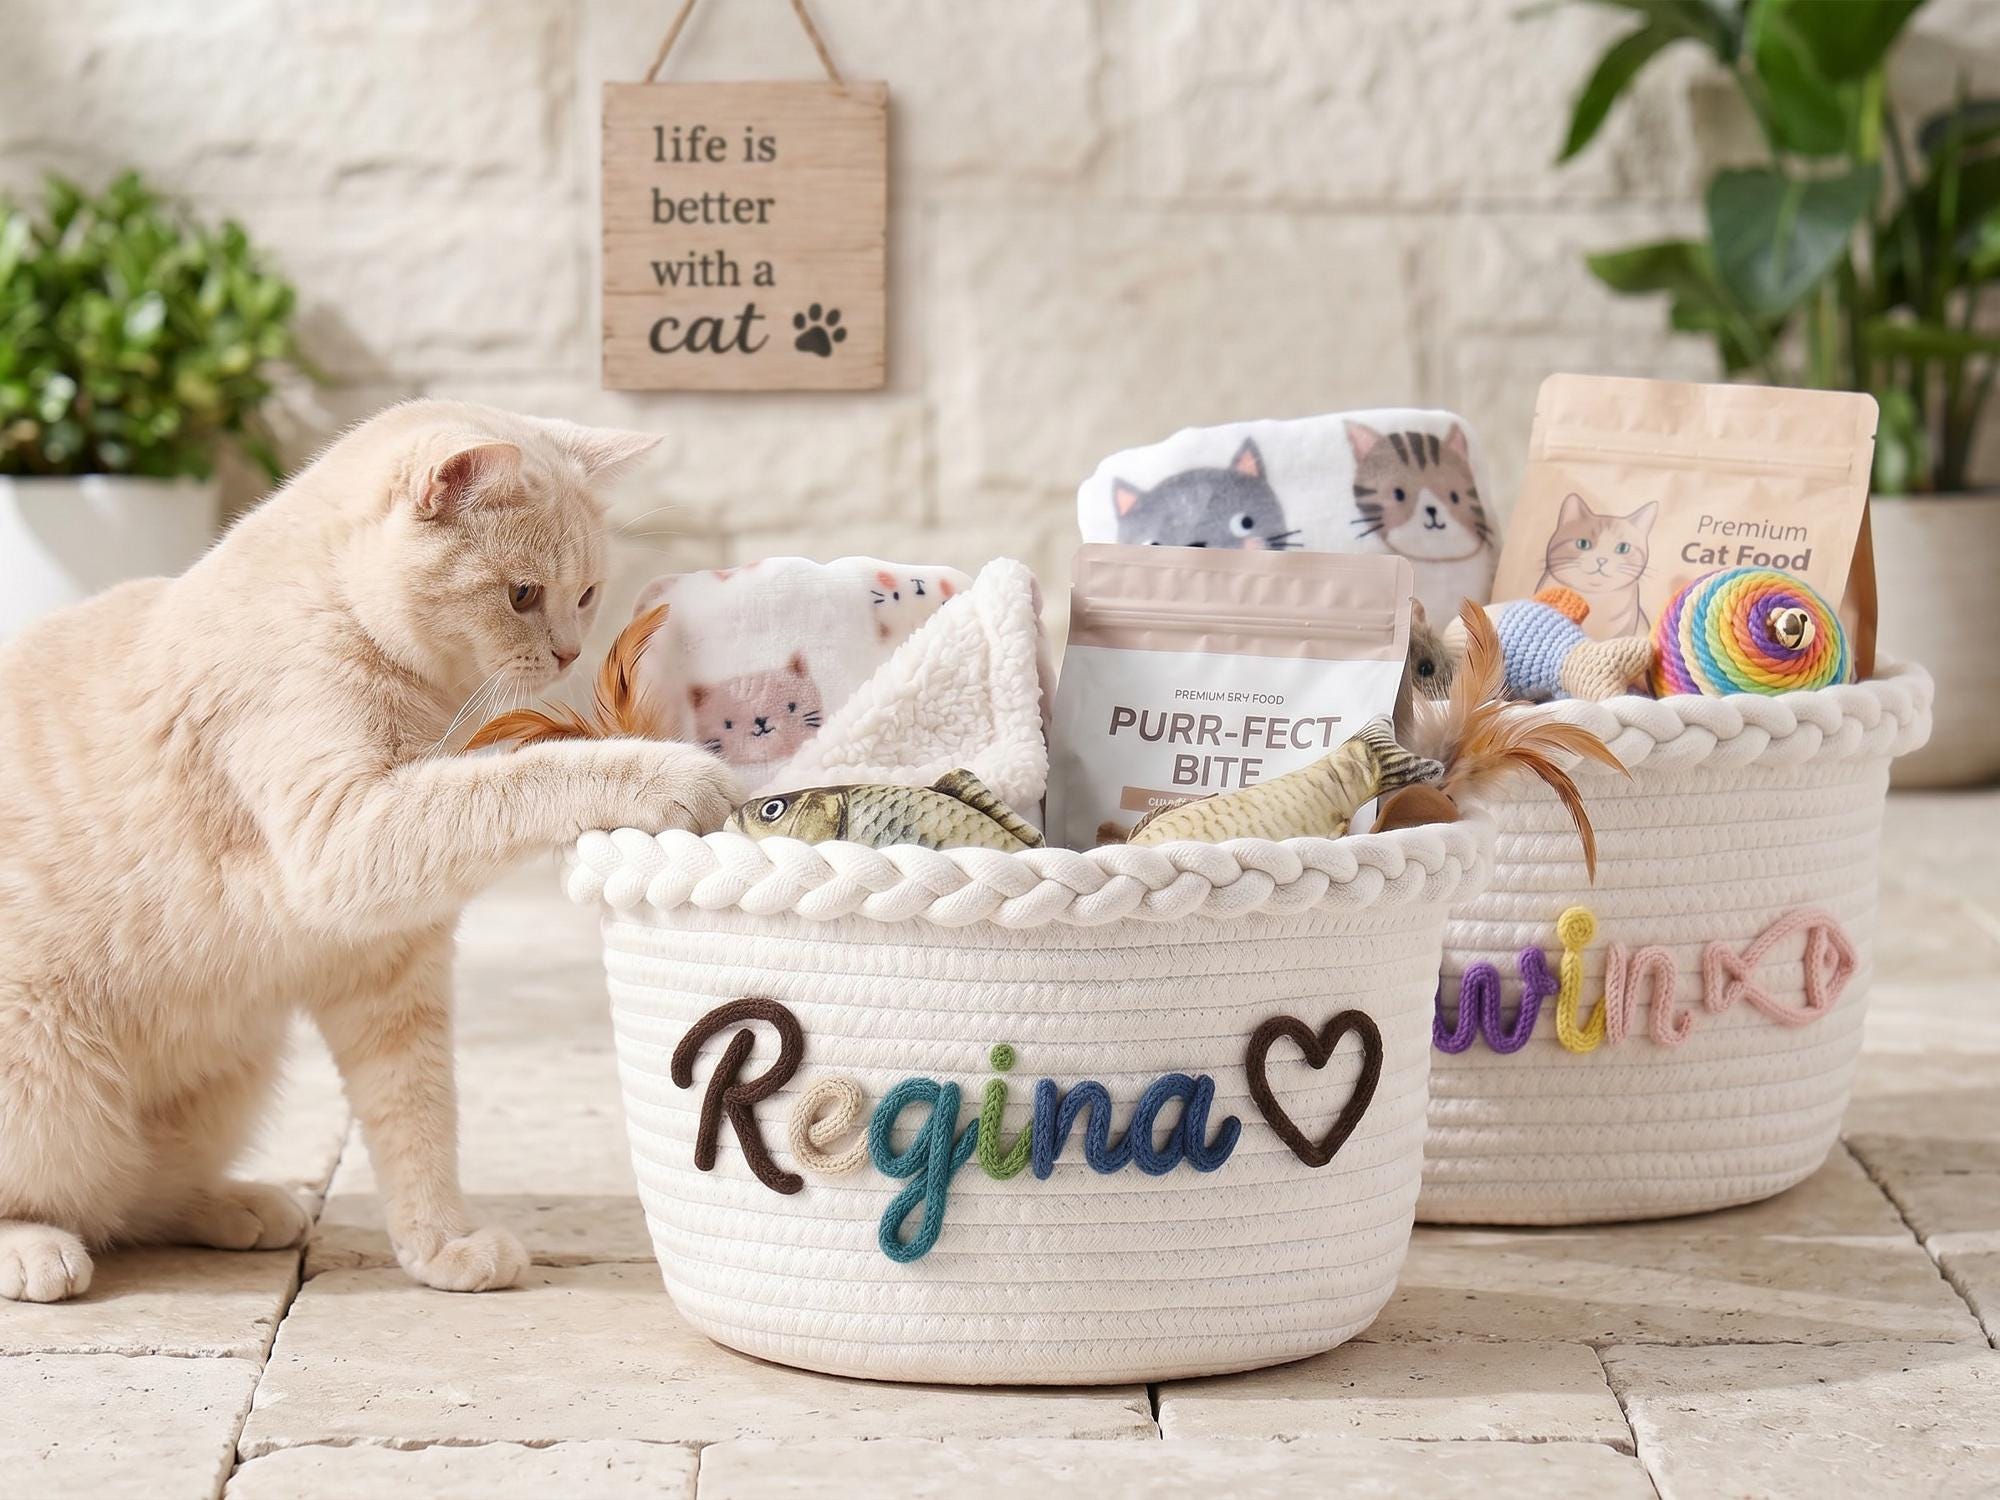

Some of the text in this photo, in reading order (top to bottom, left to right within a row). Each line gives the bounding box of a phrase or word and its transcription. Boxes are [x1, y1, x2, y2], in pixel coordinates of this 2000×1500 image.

[653, 125, 777, 163] life is
[651, 187, 775, 224] better
[650, 250, 777, 287] with a
[649, 301, 770, 355] cat
[1697, 514, 1808, 542] Premium
[1680, 542, 1812, 571] Cat Food
[1174, 689, 1225, 701] PREMIUM
[1252, 693, 1285, 705] FOOD
[1108, 705, 1342, 750] PURR-FECT
[1172, 754, 1263, 789] BITE
[671, 997, 1242, 1264] Regina
